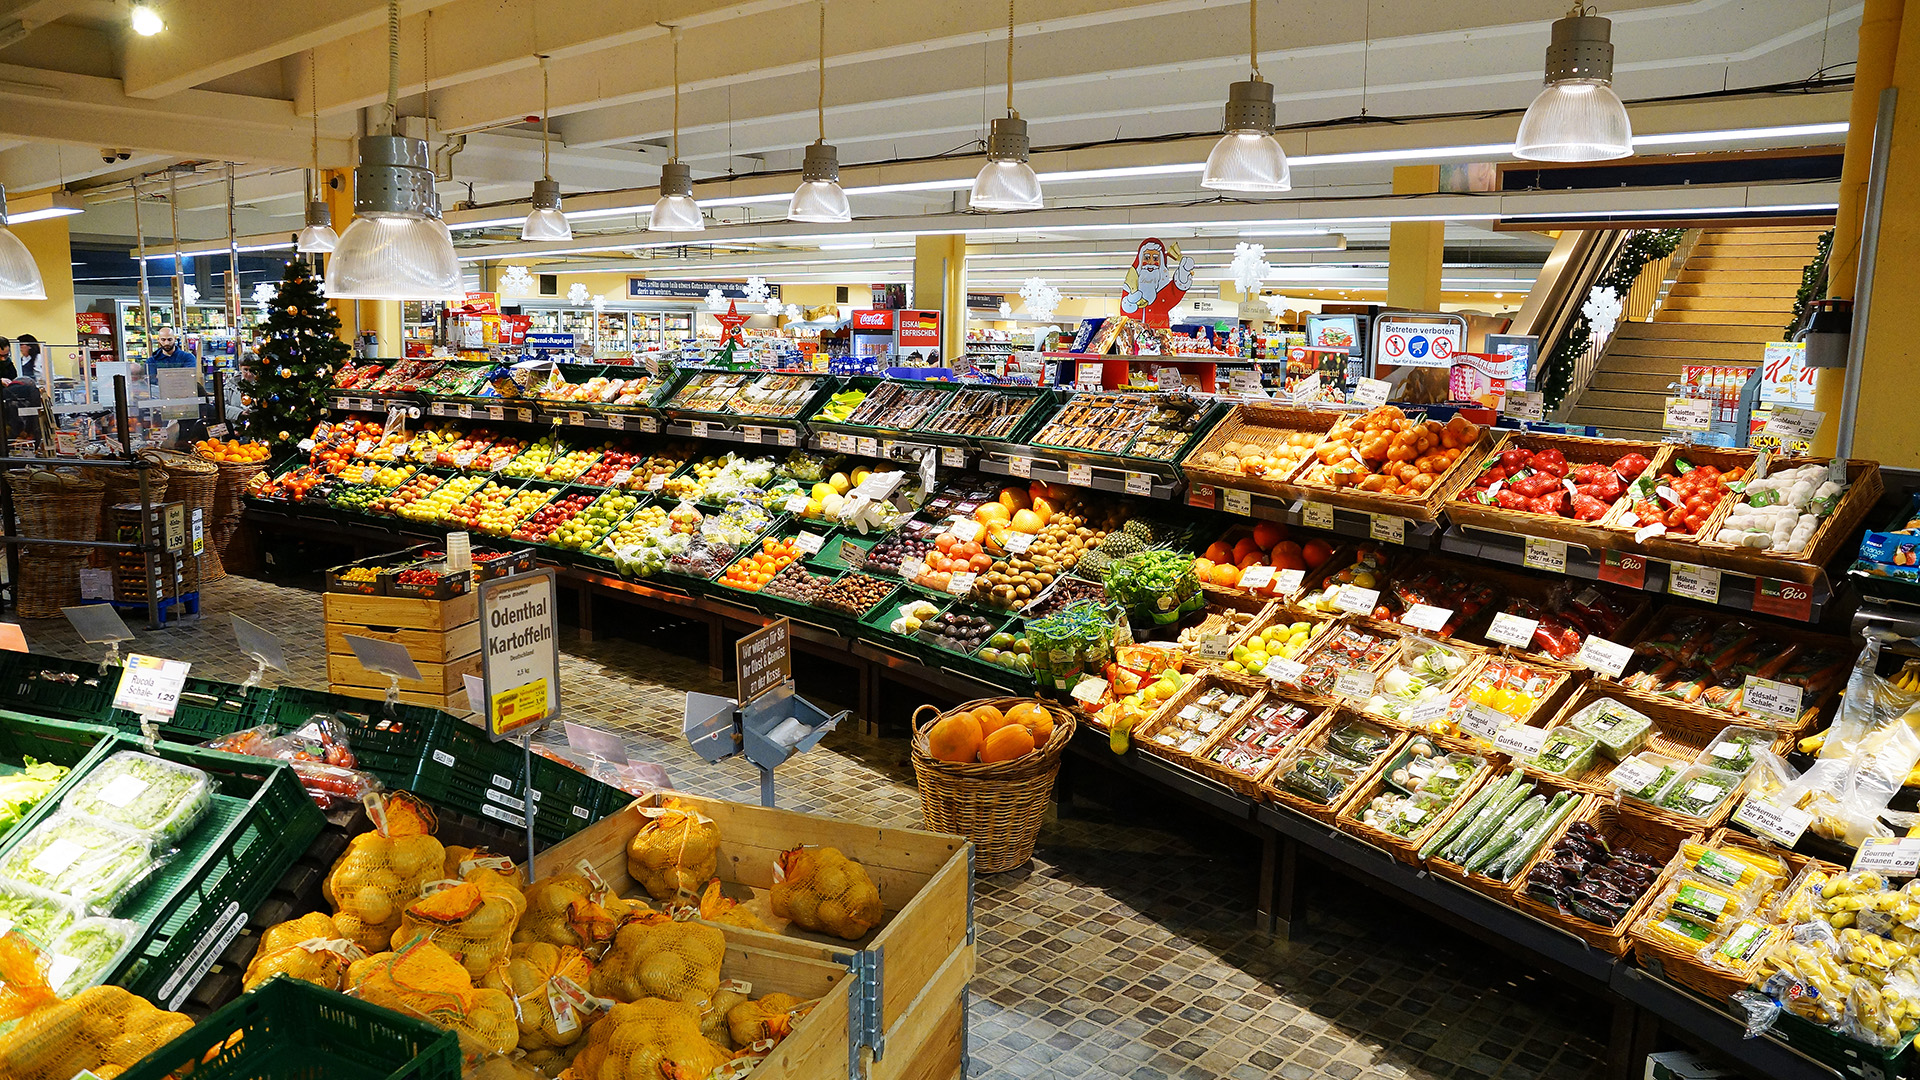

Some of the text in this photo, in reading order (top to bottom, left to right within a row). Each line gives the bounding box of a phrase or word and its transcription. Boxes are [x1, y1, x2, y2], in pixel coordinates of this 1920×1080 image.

[638, 280, 647, 288] Man
[638, 288, 649, 296] darin
[860, 313, 886, 325] Coca-Cola
[902, 329, 937, 337] ERFRISCHEN.
[1386, 326, 1454, 335] Betreten verboten
[1290, 366, 1299, 374] Mit
[1301, 366, 1314, 375] Liebe
[1765, 356, 1791, 383] K
[1800, 367, 1818, 385] K
[1771, 416, 1802, 426] Knoblauch
[1201, 488, 1212, 496] Bio
[170, 536, 183, 547] 1,99
[1530, 548, 1548, 556] Paprika
[1860, 545, 1884, 555] Ananas
[1621, 558, 1641, 569] Bio
[1676, 575, 1698, 585] Möhren
[1675, 582, 1697, 591] -Beutel-
[1761, 588, 1780, 596] EDEKA
[1781, 587, 1807, 600] Bio
[491, 598, 546, 628] Odenthal
[489, 624, 550, 656] Kartoffeln
[742, 644, 751, 659] Wir
[752, 636, 769, 653] wiegen
[777, 627, 785, 641] Sie
[510, 649, 534, 661] Deutschland
[751, 657, 763, 674] Obst
[763, 654, 767, 667] &
[768, 646, 786, 665] Gemüse
[1585, 653, 1604, 662] -Schale-
[129, 657, 139, 668] E
[131, 675, 154, 686] Rucola
[750, 667, 781, 693] an der Kasse
[1340, 678, 1358, 686] Zucchini
[127, 685, 175, 701] -Schale- 1,29
[1748, 690, 1778, 702] Feldsalat
[1748, 697, 1796, 713] -Schale- 1,99
[1467, 713, 1488, 726] Mangold
[1498, 735, 1523, 748] Gurken
[1524, 745, 1538, 753] 1,29
[1745, 802, 1782, 823] Zuckermais
[1742, 809, 1796, 837] -2er Pack- 2,49
